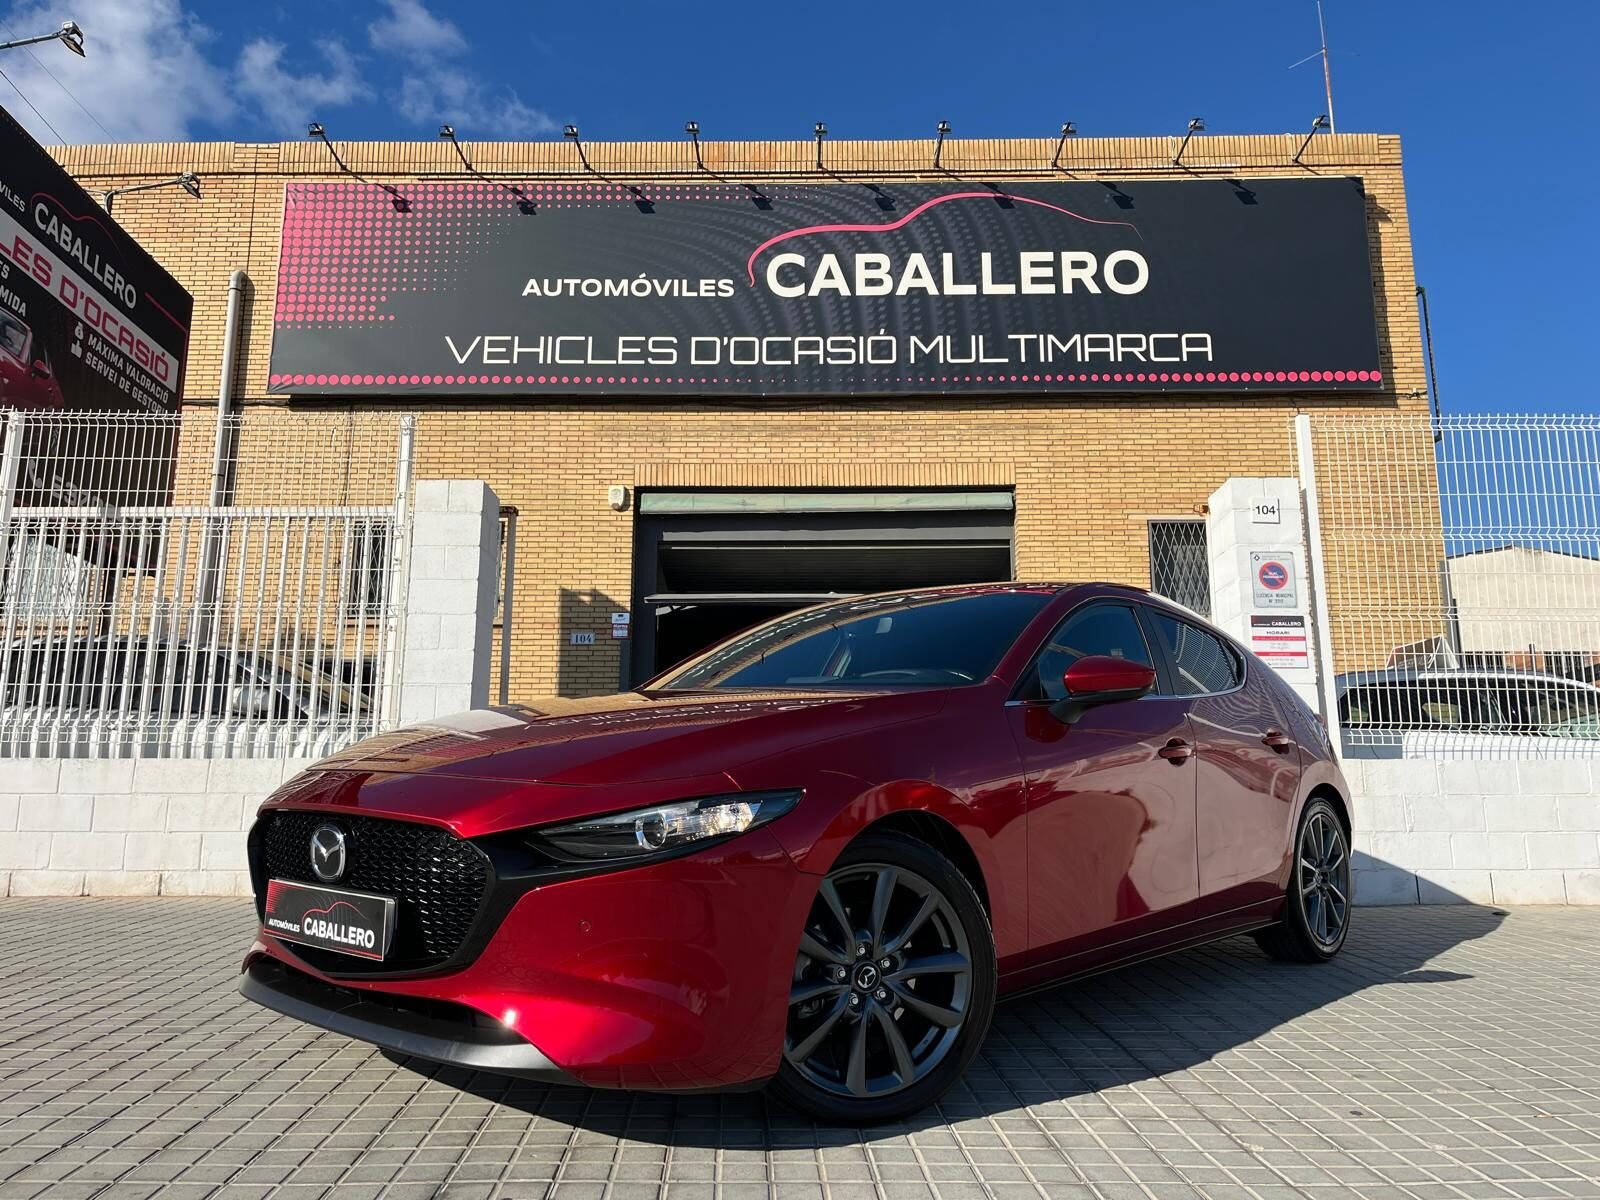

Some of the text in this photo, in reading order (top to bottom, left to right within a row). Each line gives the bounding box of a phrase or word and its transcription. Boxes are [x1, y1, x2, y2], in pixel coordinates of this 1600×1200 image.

[34, 202, 137, 309] CABALLERO
[521, 250, 1149, 298] AUTOMÓVILES CABALLERO
[59, 274, 169, 382] D'OCASIÓ
[445, 328, 1213, 365] VEHICLES D'OCASIÓ MULTIMARCA
[85, 352, 117, 384] SERVEI
[118, 376, 131, 394] DE
[126, 362, 169, 404] VALORACIÓ
[1255, 505, 1276, 515] 104
[575, 634, 592, 644] 104
[268, 917, 375, 949] AUTOMÓVILES CABALLERO
